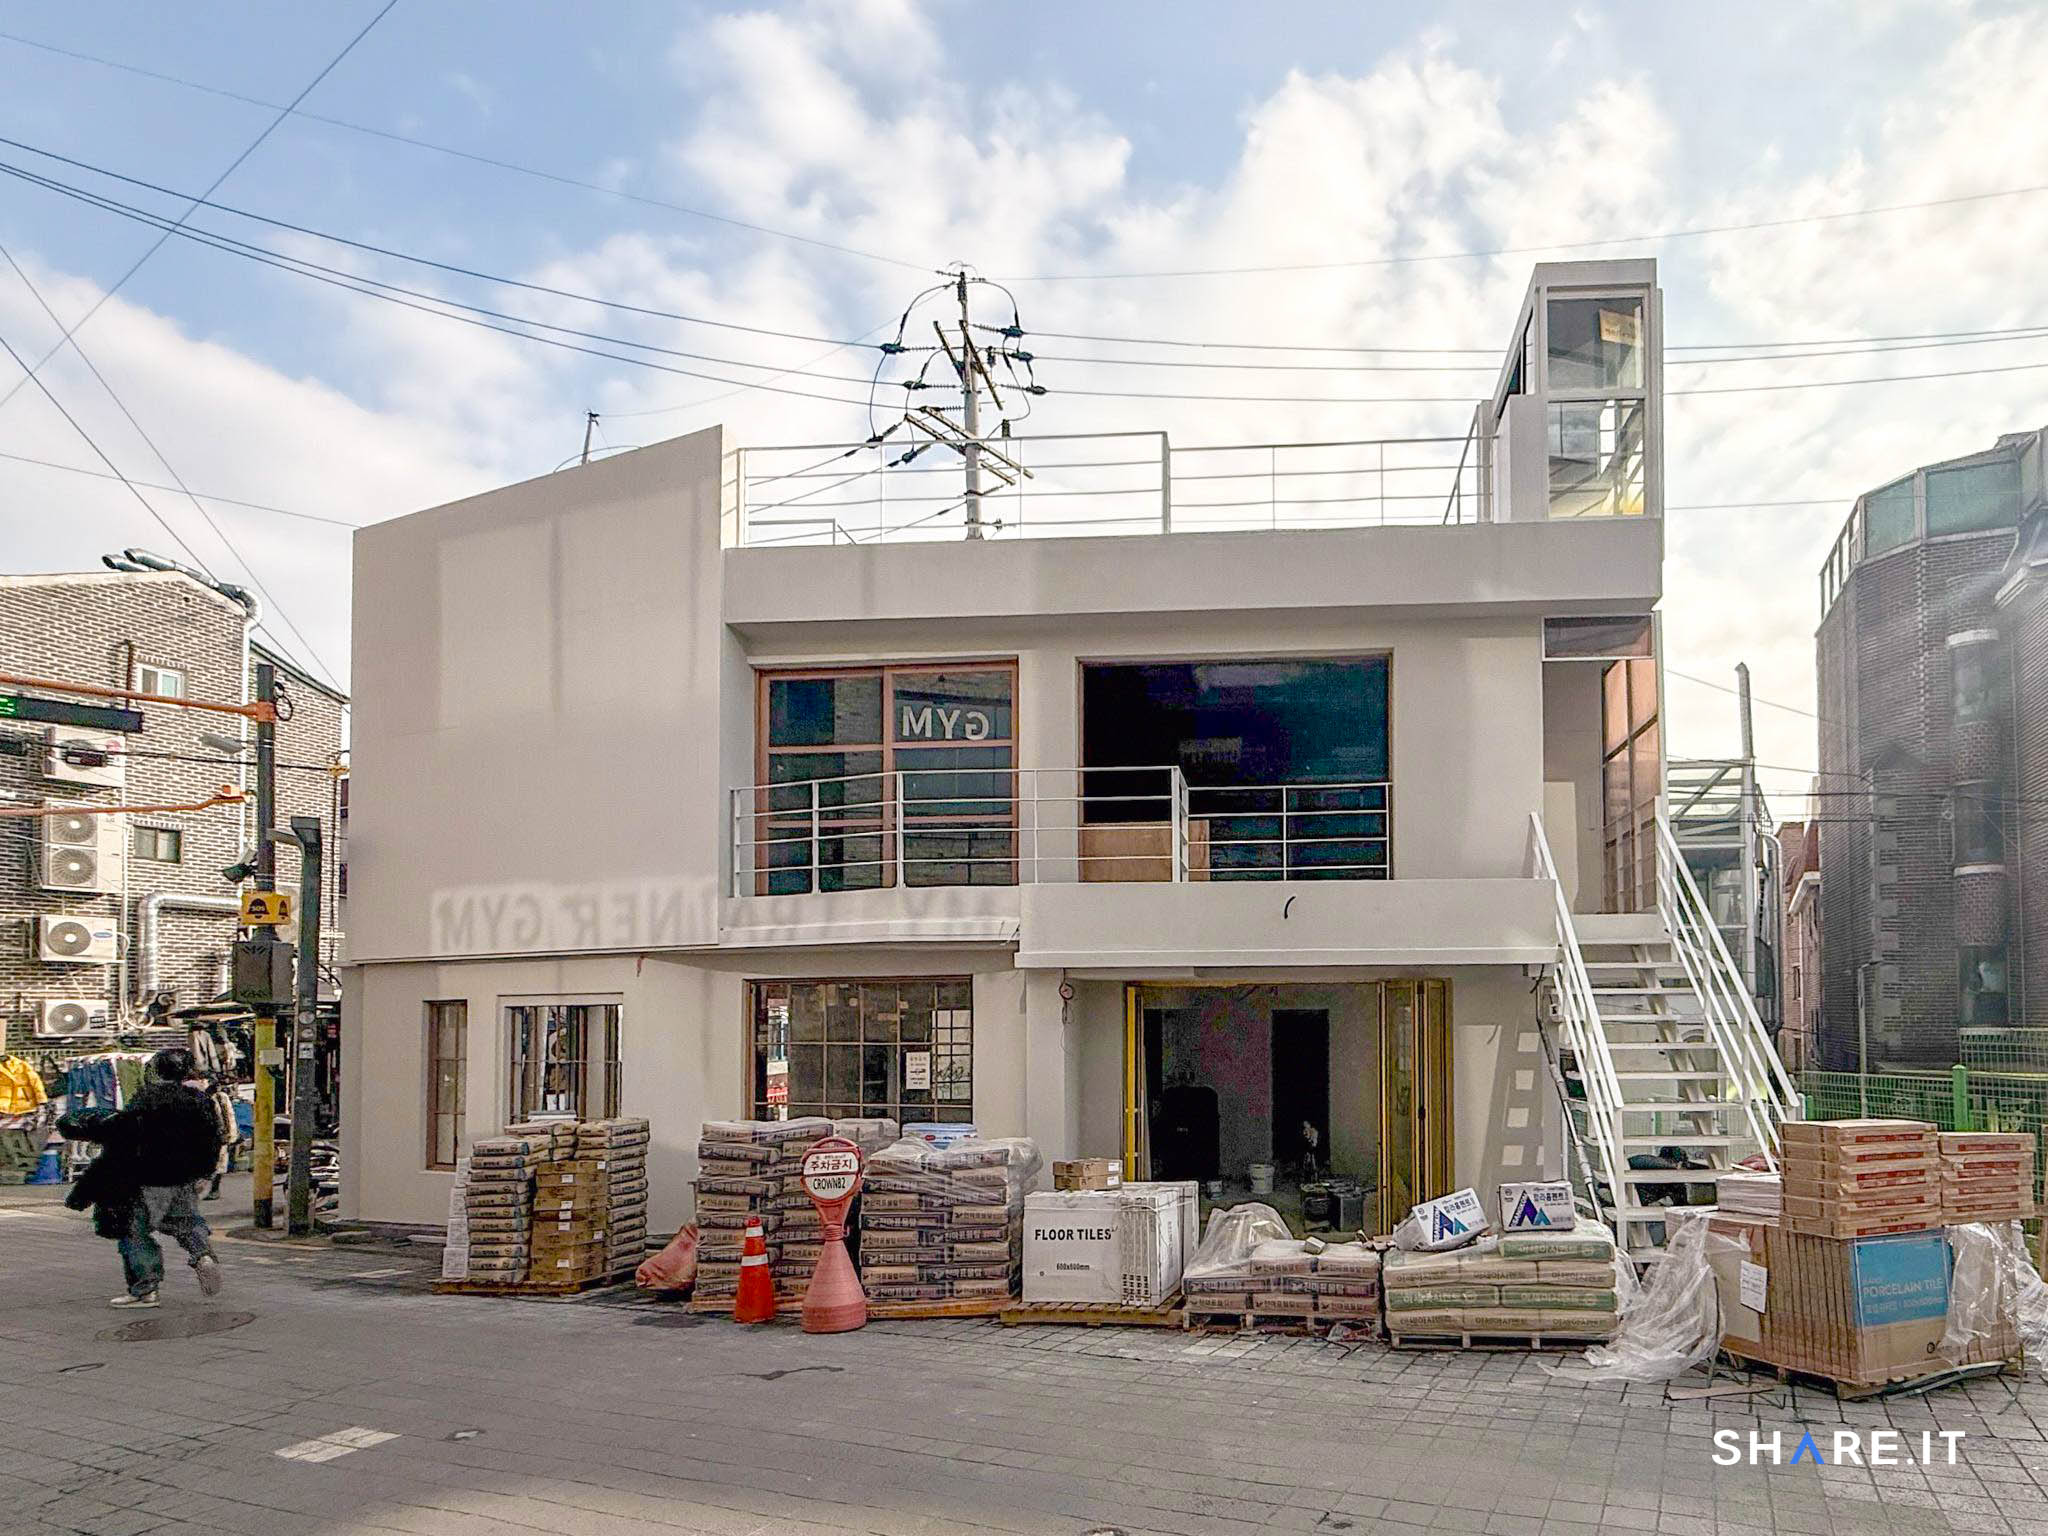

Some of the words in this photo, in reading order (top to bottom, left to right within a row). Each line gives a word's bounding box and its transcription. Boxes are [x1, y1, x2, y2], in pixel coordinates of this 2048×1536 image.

[810, 1159, 852, 1171] 주차금지
[1034, 1229, 1074, 1241] FLOOR
[1078, 1228, 1112, 1241] TILES
[1863, 1282, 1922, 1297] PORCELAIN
[1925, 1278, 1945, 1290] TILE
